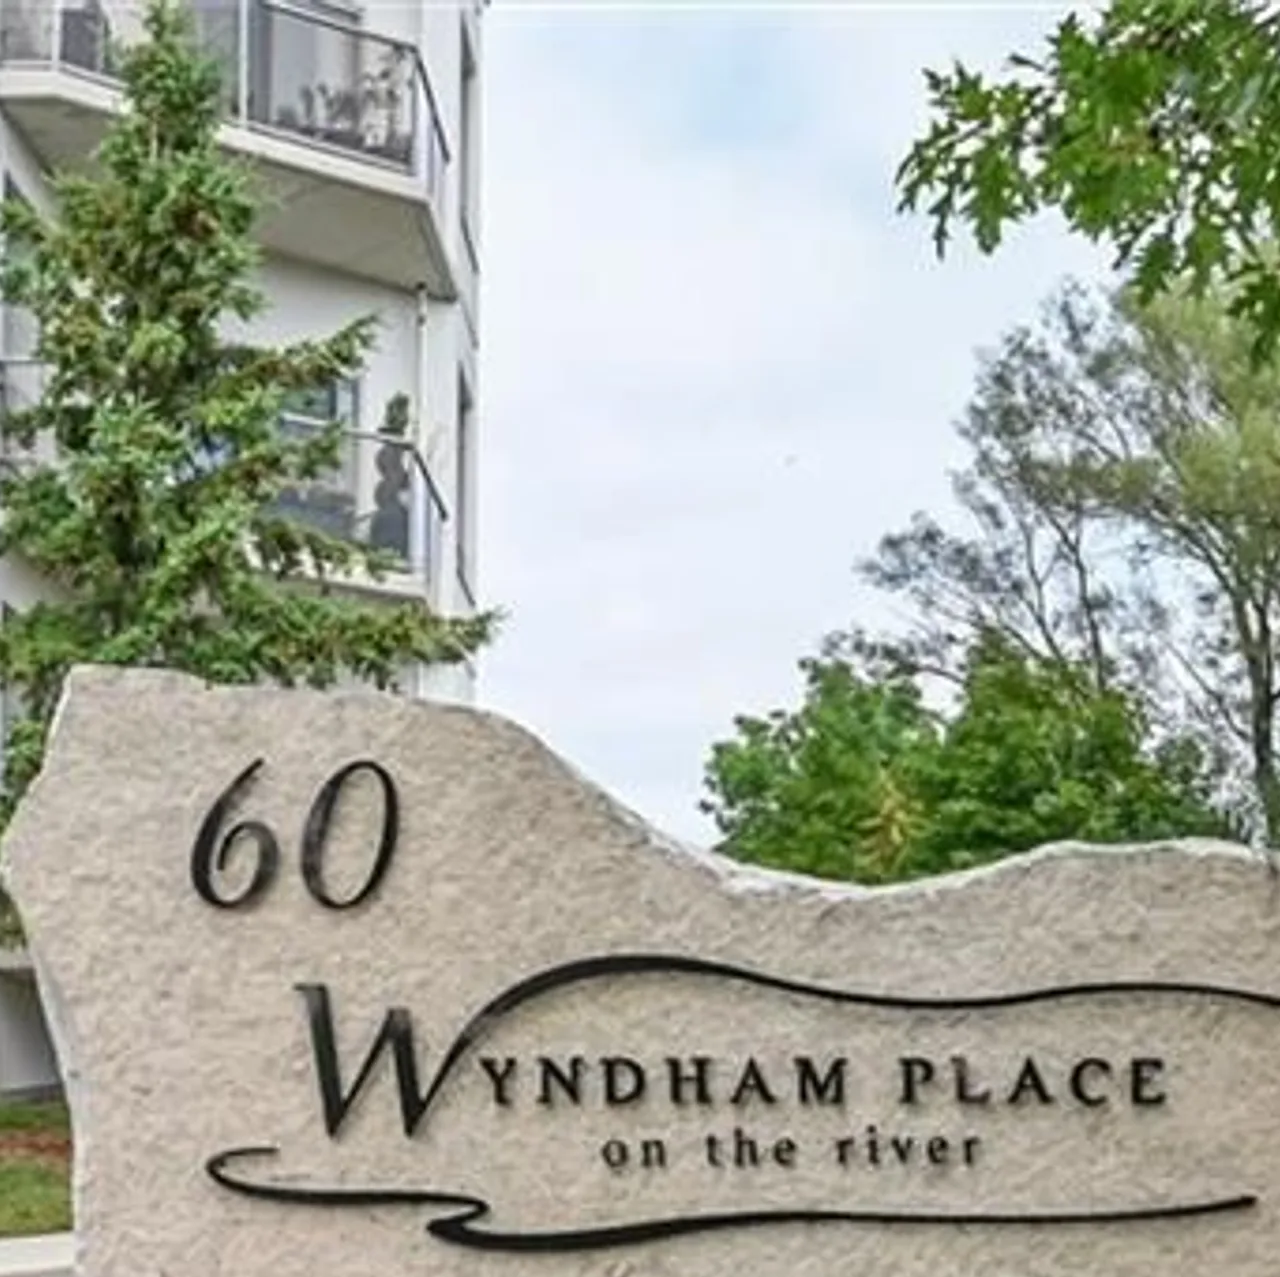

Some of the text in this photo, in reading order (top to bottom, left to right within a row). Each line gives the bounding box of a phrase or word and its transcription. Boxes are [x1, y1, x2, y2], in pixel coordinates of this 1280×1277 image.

[190, 759, 400, 912] 60
[295, 984, 1168, 1138] WYNDHAM PLACE
[601, 1125, 981, 1169] on the river
